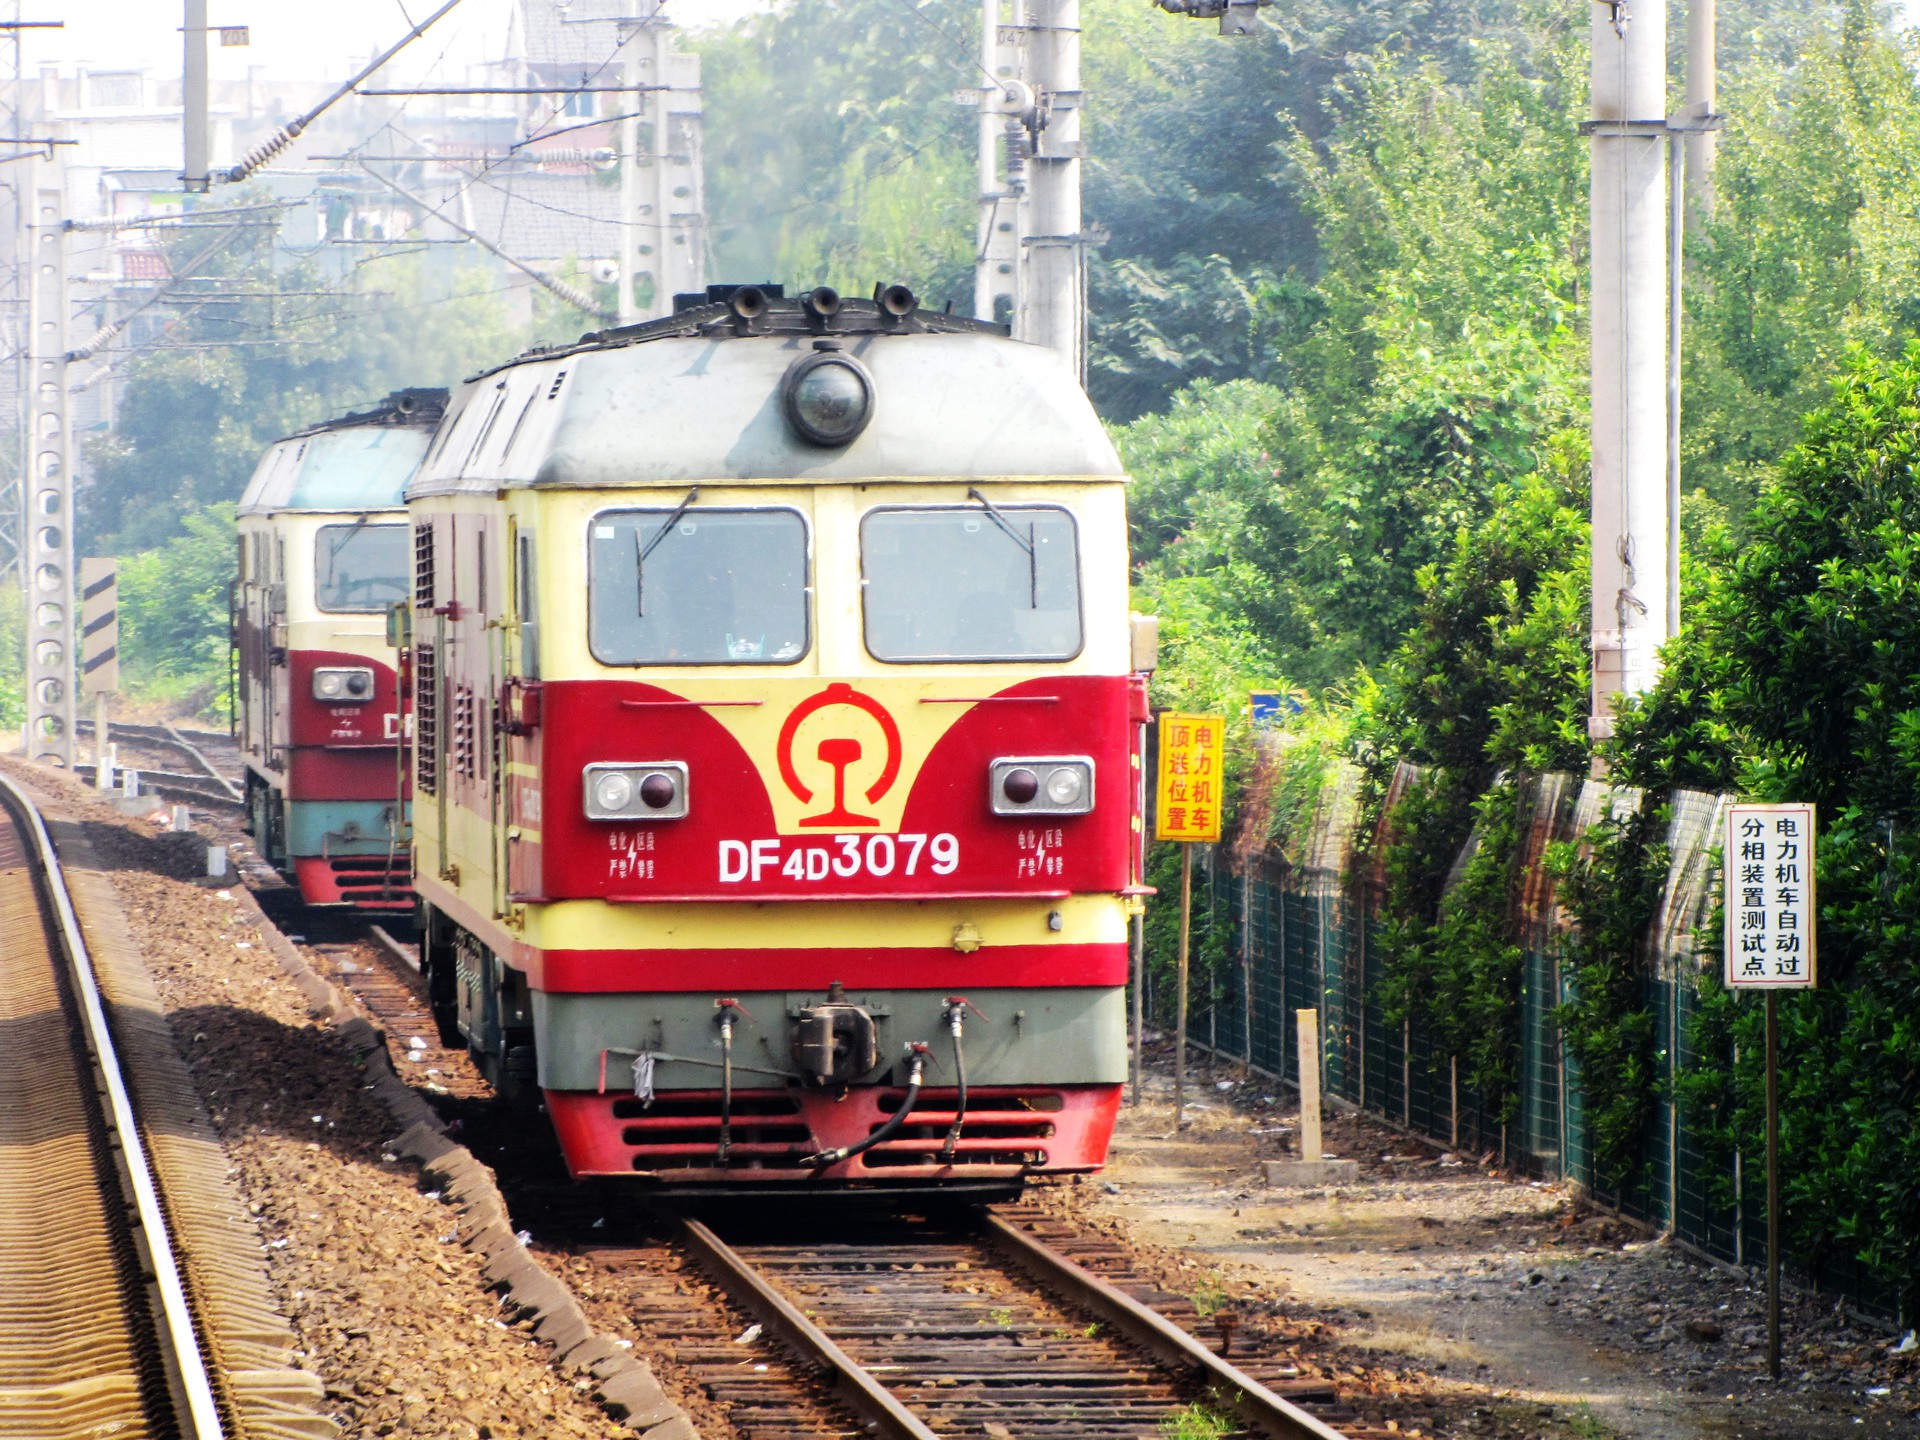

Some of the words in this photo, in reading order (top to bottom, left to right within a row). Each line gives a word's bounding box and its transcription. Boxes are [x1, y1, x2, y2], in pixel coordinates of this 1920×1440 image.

[1166, 725, 1190, 831] 顶送位置
[1191, 725, 1213, 831] 电力机车
[719, 832, 960, 882] DF4D3079
[1741, 818, 1766, 976] 分相装置测试点
[1775, 818, 1800, 976] 电力机车自动过
